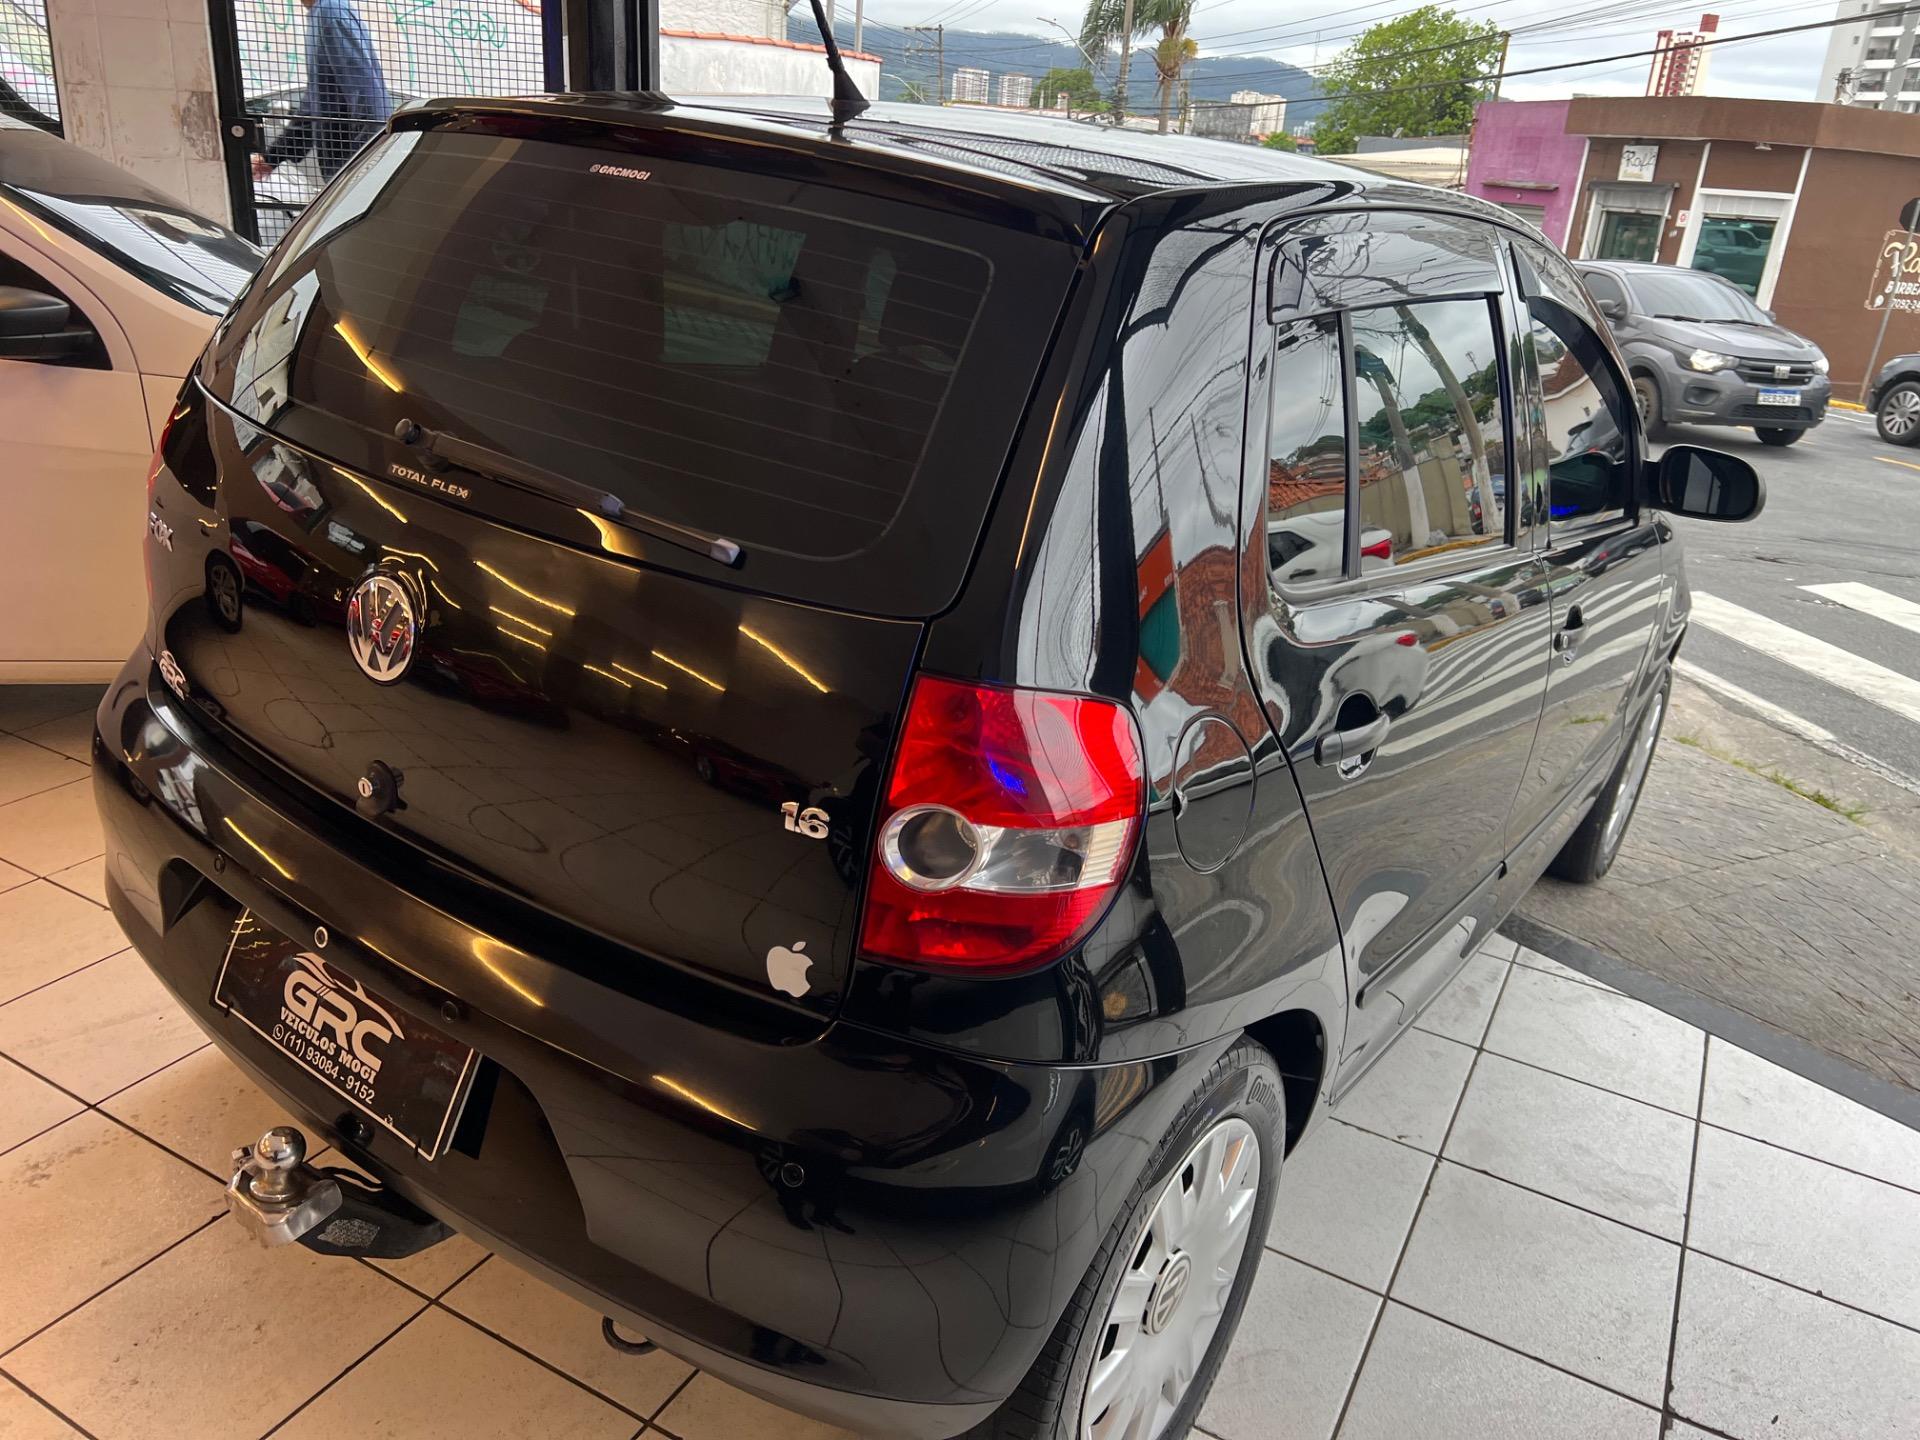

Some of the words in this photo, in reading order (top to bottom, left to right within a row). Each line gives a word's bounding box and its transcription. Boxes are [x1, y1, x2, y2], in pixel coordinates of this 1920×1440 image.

[391, 464, 428, 485] TOTAL
[431, 478, 469, 499] FLEX
[280, 1006, 337, 1056] VEICULOS
[338, 1049, 377, 1085] MOGI
[283, 969, 394, 1072] GRC
[283, 1031, 306, 1057] (11)
[306, 1046, 339, 1080] 93084
[345, 1075, 375, 1105] 9152
